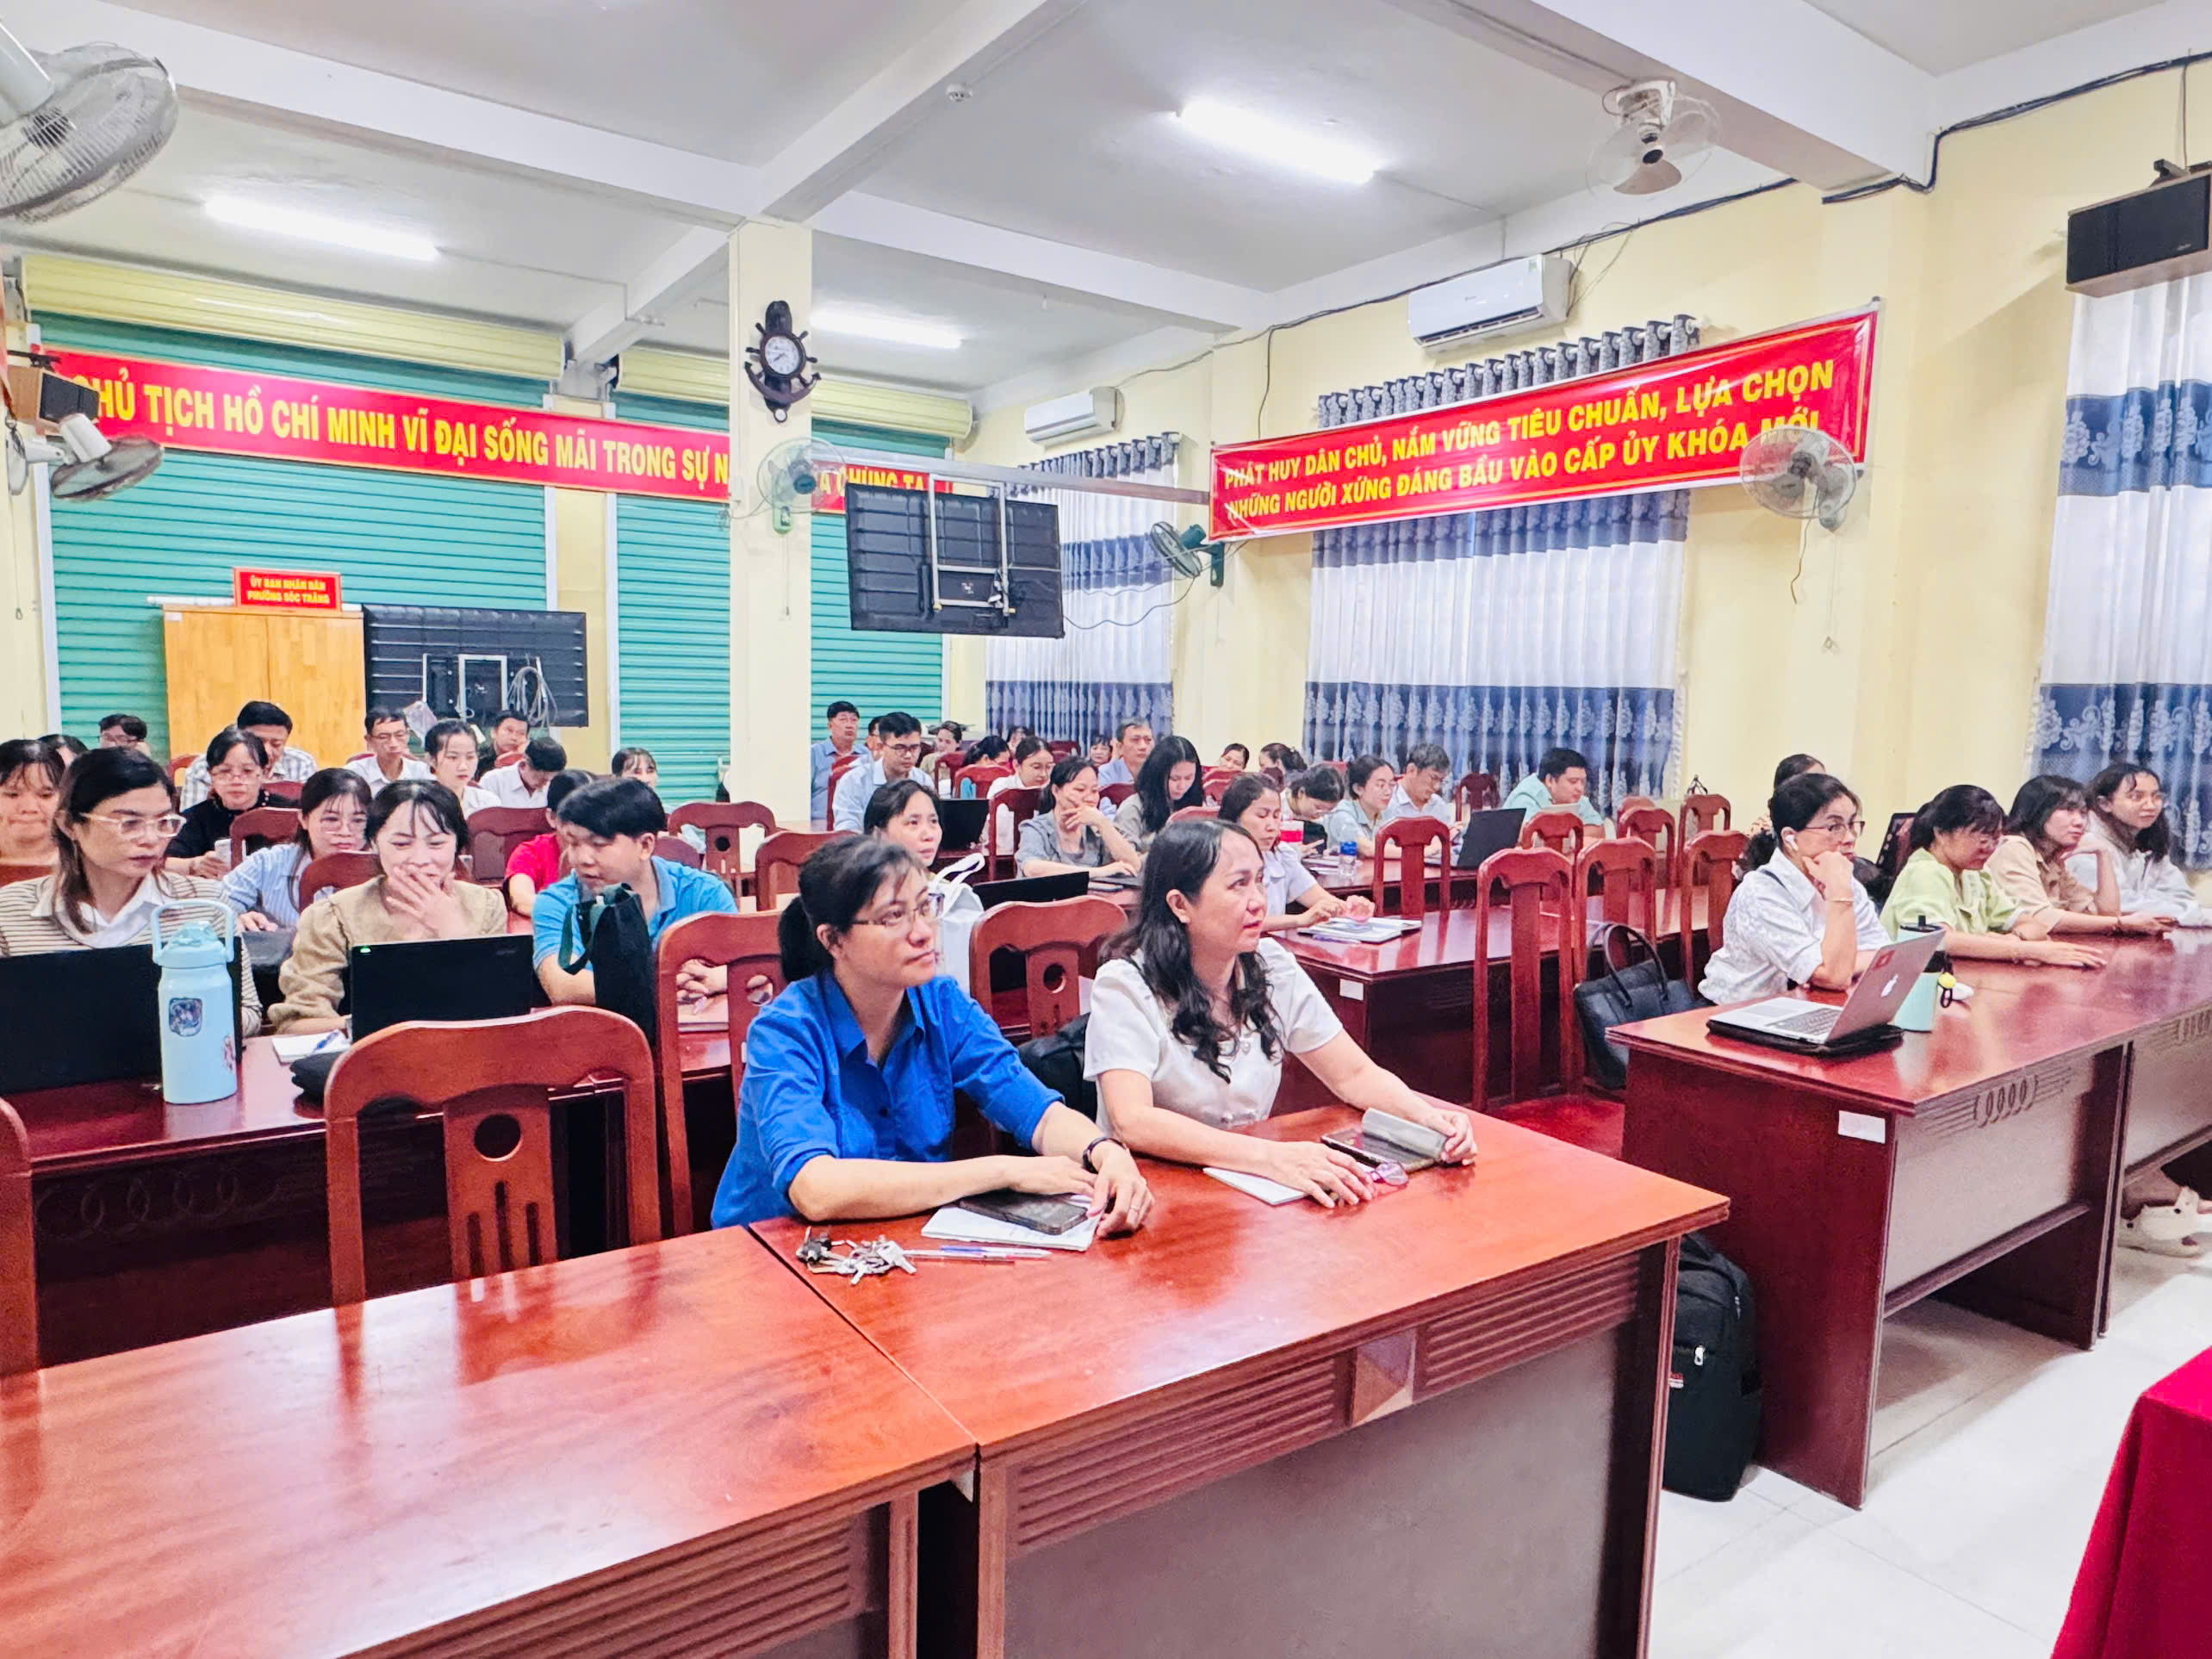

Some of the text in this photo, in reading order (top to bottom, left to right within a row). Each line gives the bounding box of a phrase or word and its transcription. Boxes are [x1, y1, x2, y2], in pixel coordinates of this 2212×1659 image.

[74, 367, 135, 421] HỦ
[144, 384, 214, 436] TỊCH
[223, 385, 263, 435] HỒ
[271, 395, 320, 441] CHÍ
[326, 407, 395, 449] MINH
[401, 407, 428, 453] VĨ
[433, 419, 477, 467] ĐẠI
[483, 416, 549, 466] SỐNG
[555, 428, 597, 470] MÃI
[602, 439, 676, 480] TRONG
[681, 444, 710, 490] SỰ
[1225, 461, 1265, 489] PHÁT
[1268, 457, 1302, 482] HUY
[1305, 447, 1340, 476] DÂN
[1345, 434, 1387, 469] CHỦ,
[1392, 426, 1437, 461] NẮM
[1441, 421, 1501, 452] VỮNG
[1507, 407, 1562, 442] TIÊU
[1675, 376, 1733, 418] LỰA
[1742, 358, 1834, 402] CHỌN
[1227, 492, 1281, 520] NHỮNG
[1283, 480, 1337, 513] NGƯỜI
[1340, 475, 1392, 505] XỨNG
[1396, 466, 1453, 497] ĐÁNG
[1458, 454, 1503, 488] BẦU
[1508, 448, 1558, 481] VÀO
[1563, 436, 1616, 474] CẤP
[1623, 429, 1661, 466] ỦY
[1667, 419, 1749, 460] KHÓA
